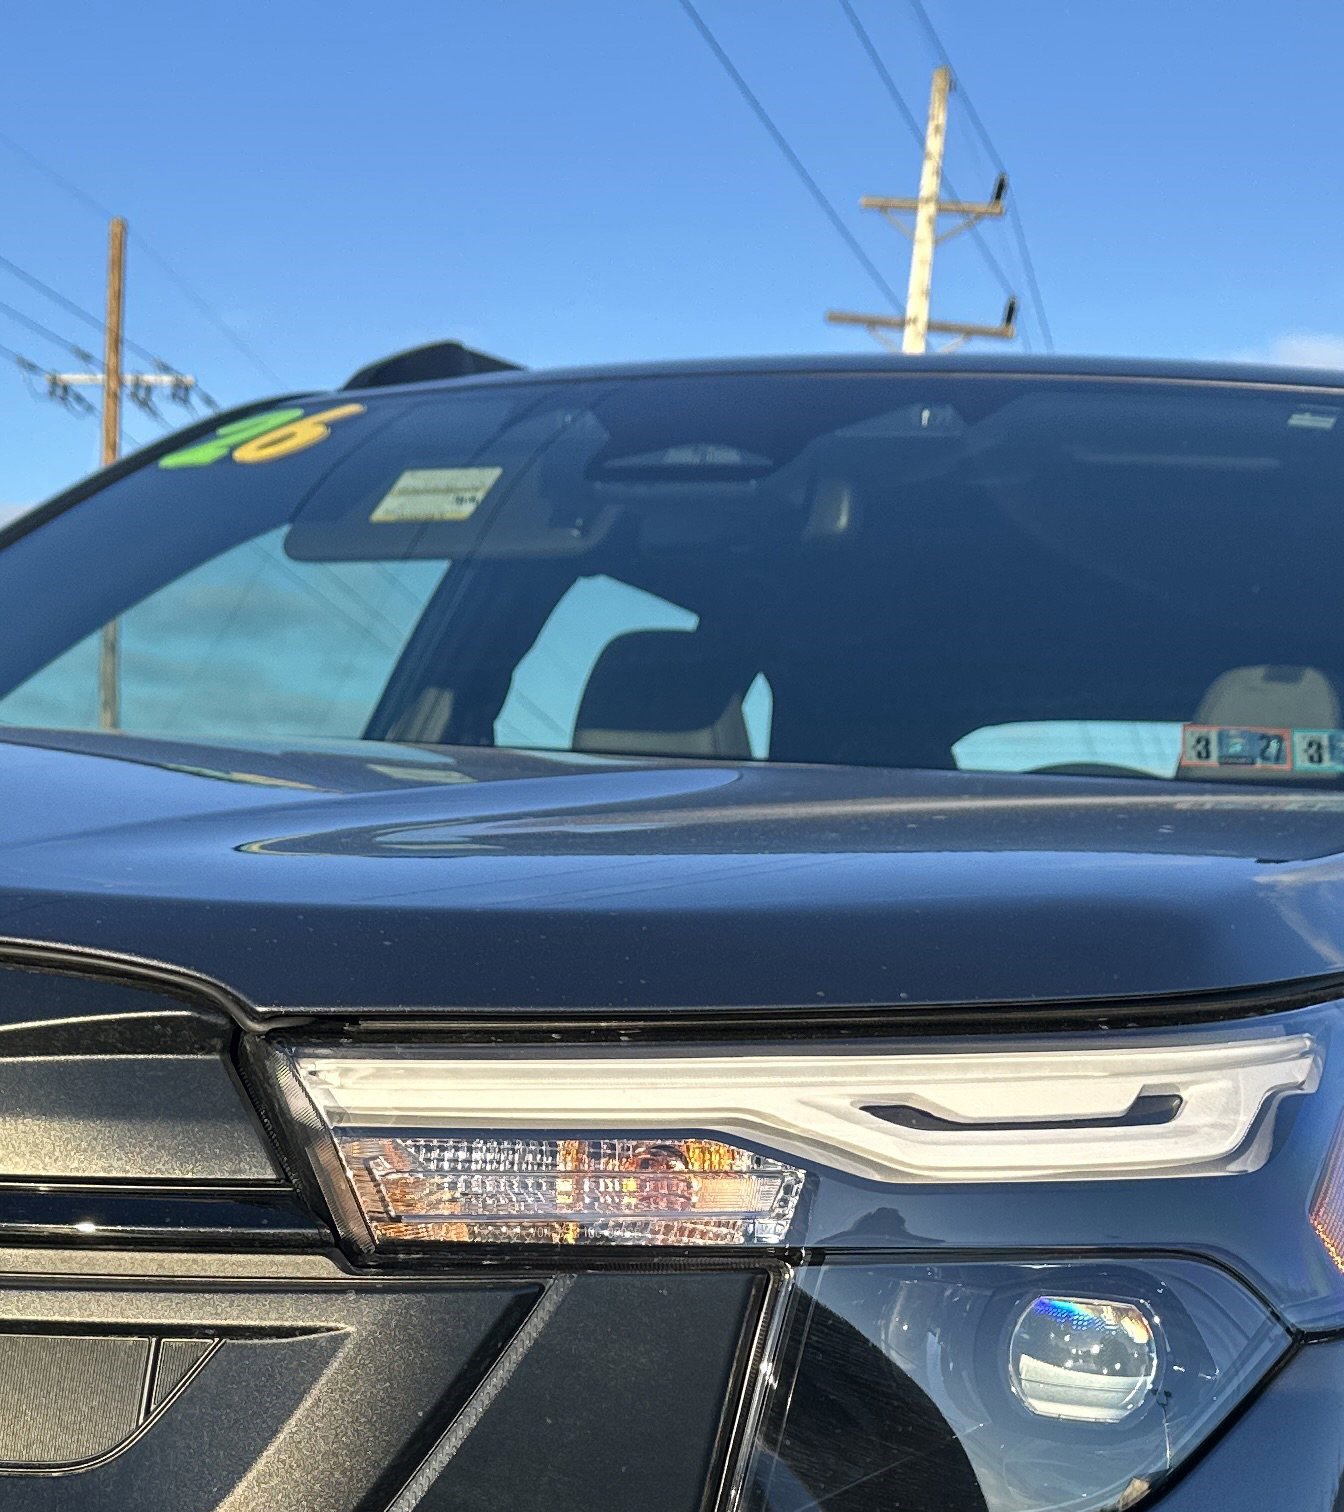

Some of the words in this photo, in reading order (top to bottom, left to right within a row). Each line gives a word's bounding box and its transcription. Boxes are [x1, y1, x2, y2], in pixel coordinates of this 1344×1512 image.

[1193, 735, 1211, 760] 3
[1258, 733, 1284, 764] 27
[1304, 739, 1323, 763] 3
